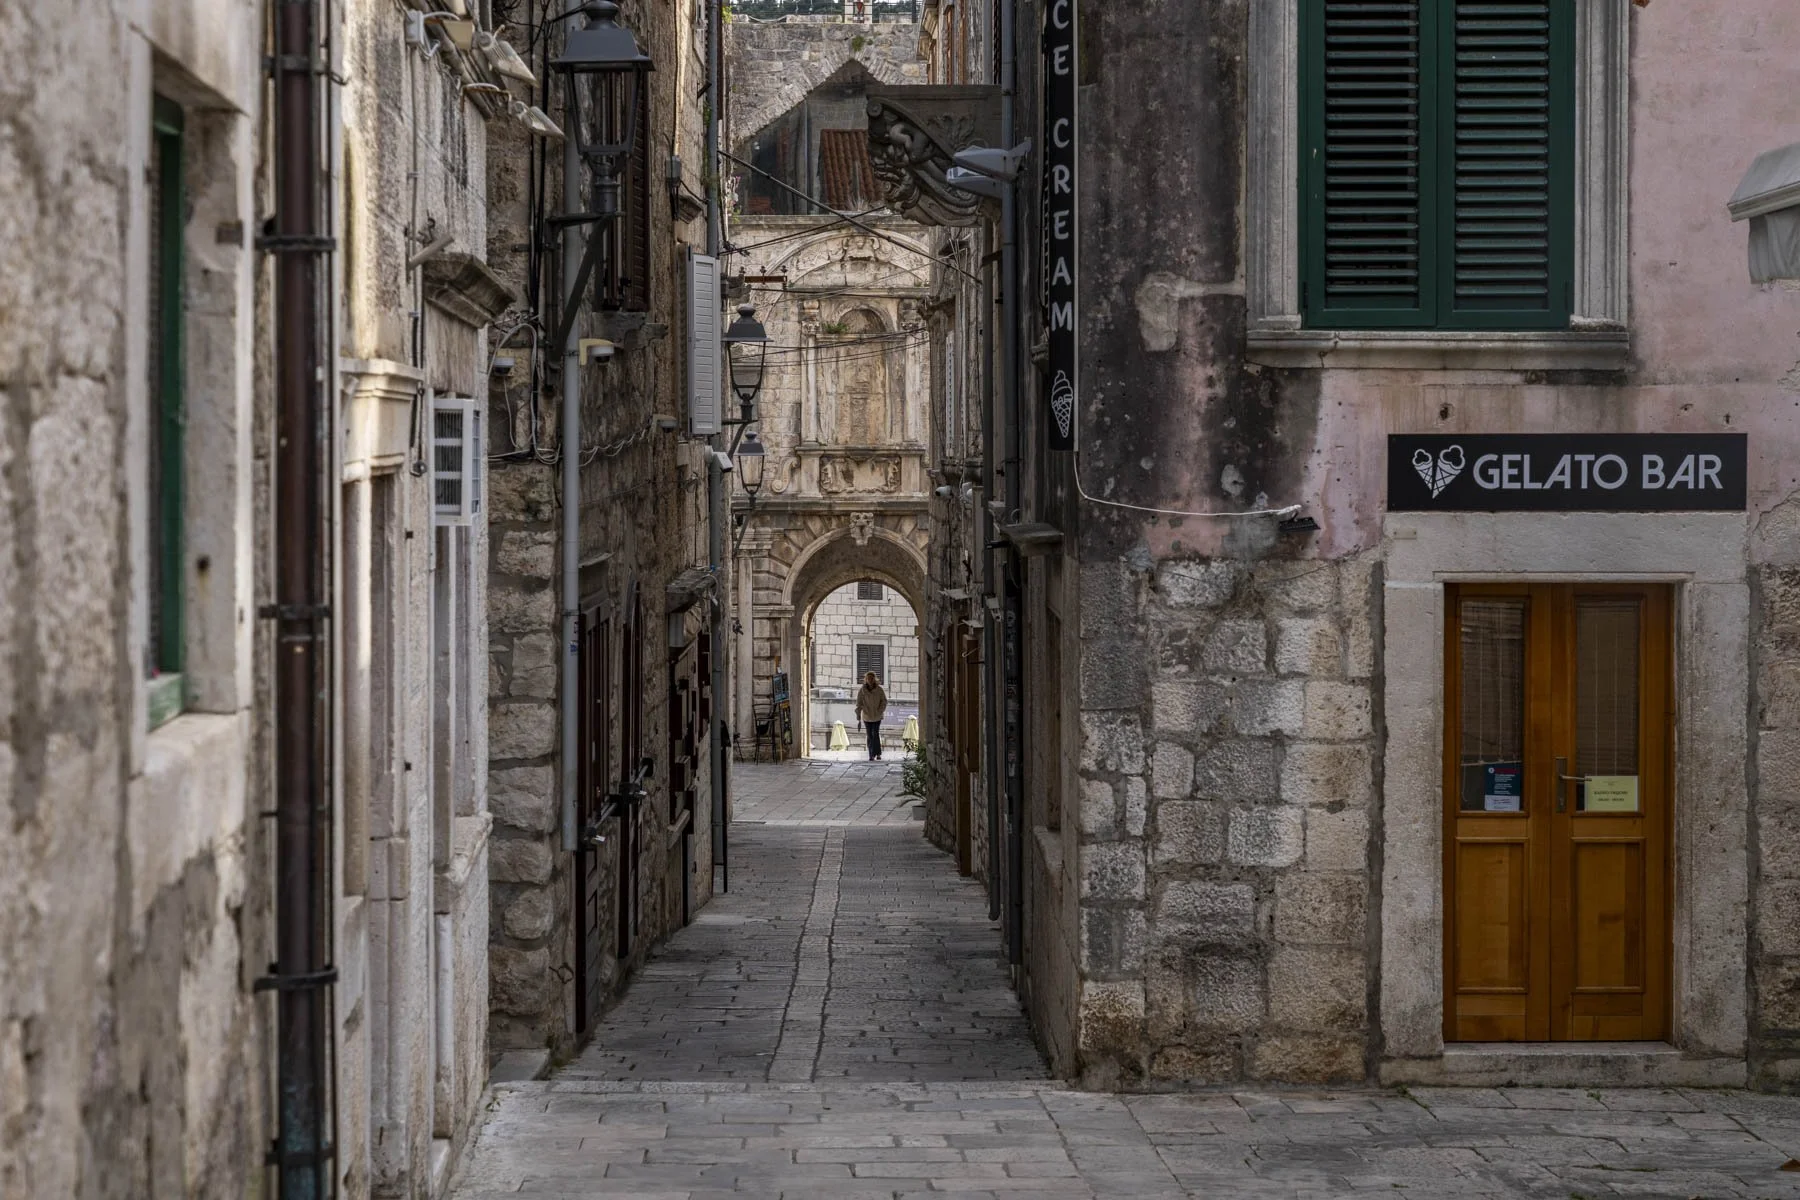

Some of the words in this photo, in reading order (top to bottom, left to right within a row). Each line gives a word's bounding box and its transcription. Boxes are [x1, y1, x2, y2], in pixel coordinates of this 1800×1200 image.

[1051, 118, 1073, 332] CREAM
[1472, 453, 1629, 490] GELATO
[1642, 453, 1724, 490] BAR
